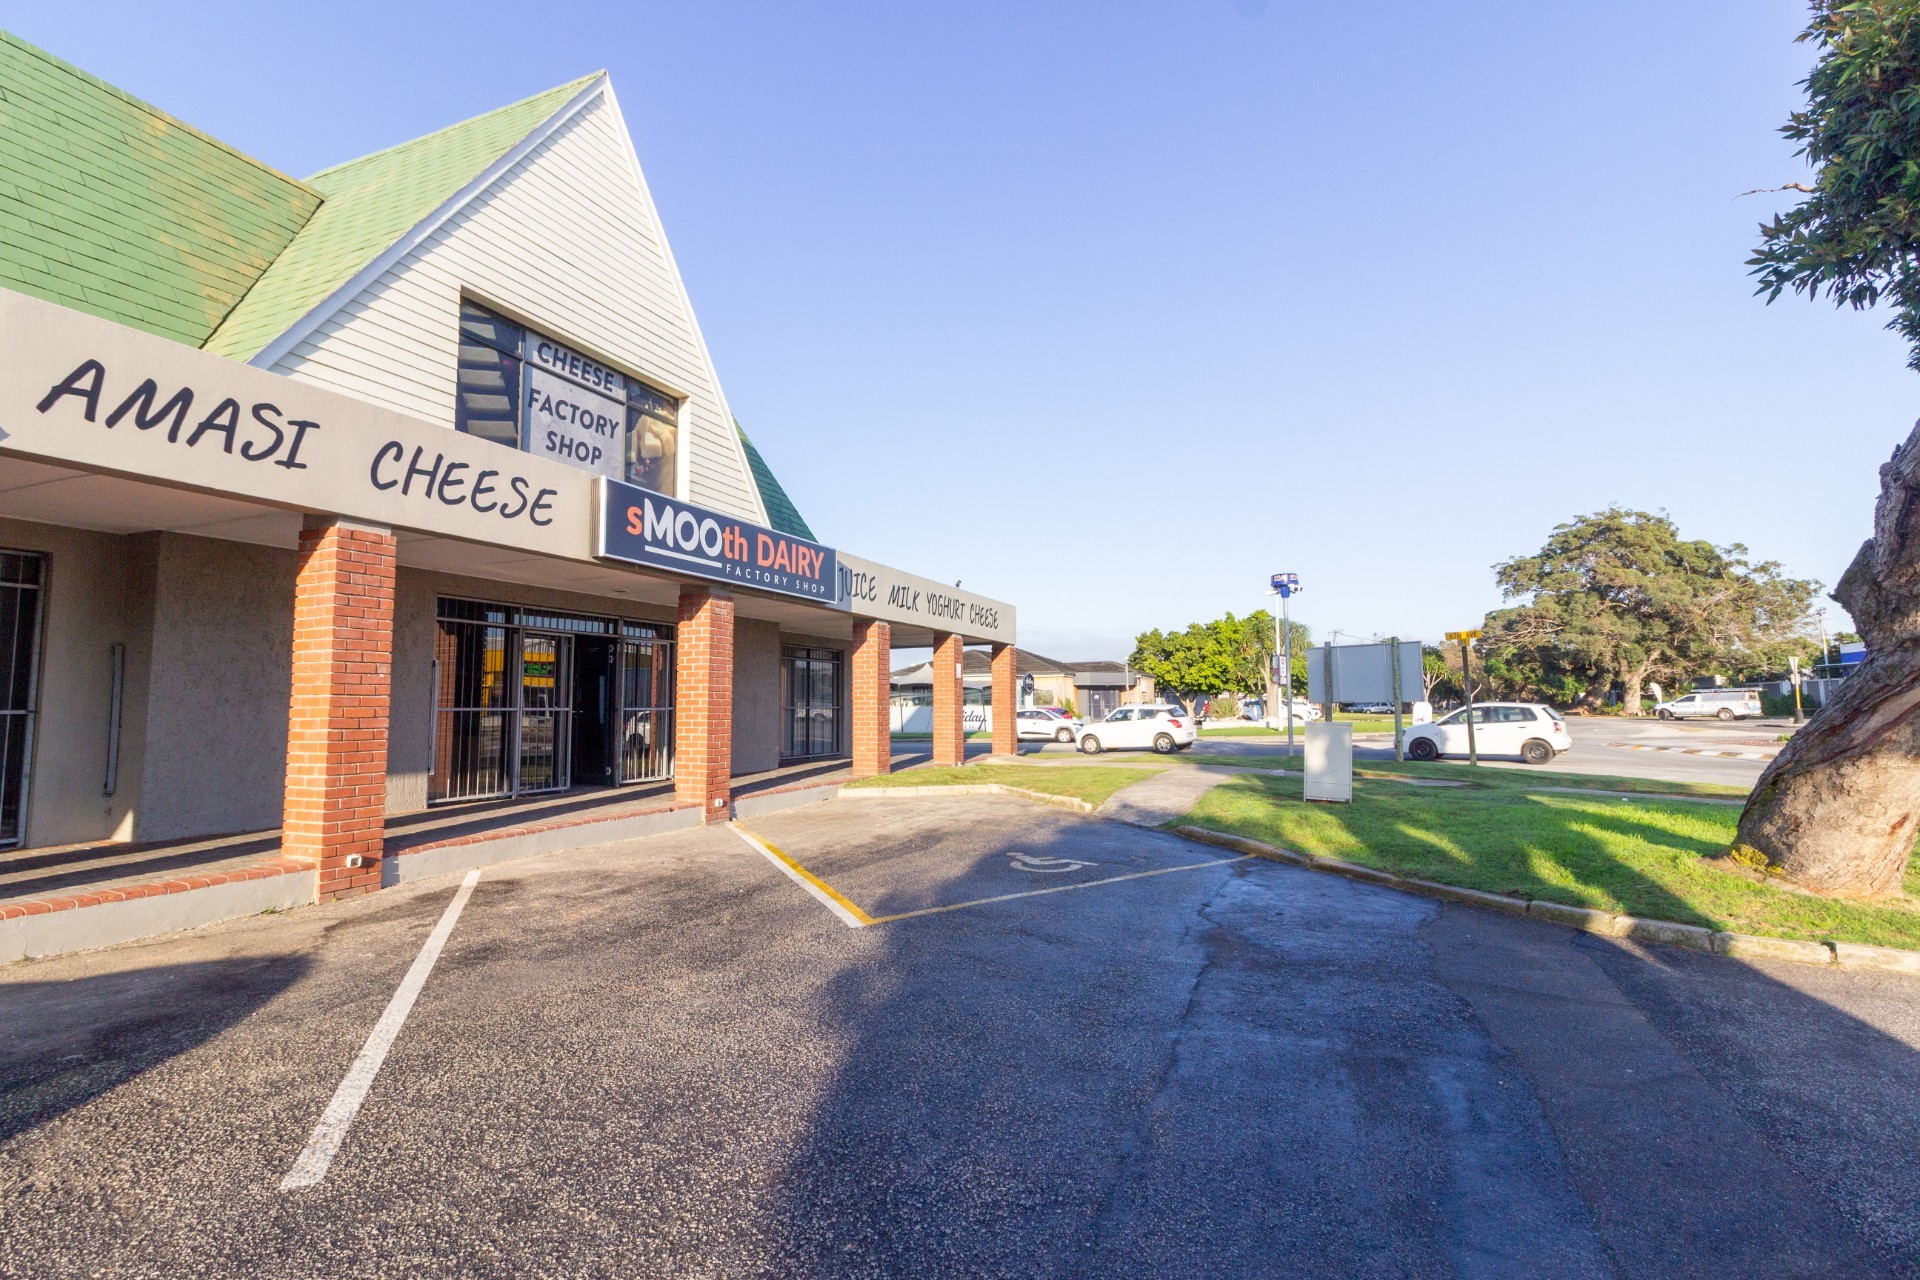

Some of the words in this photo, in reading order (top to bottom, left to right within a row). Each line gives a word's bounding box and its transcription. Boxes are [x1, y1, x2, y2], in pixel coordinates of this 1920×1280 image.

[537, 342, 615, 392] CHEESE
[527, 387, 620, 439] FACTORY
[36, 359, 320, 470] AMASI
[370, 440, 558, 526] CHEESE
[545, 431, 603, 465] SHOP
[626, 498, 748, 562] sMOOth
[757, 533, 825, 580] DAIRY
[726, 563, 788, 587] FACTORY
[796, 579, 826, 595] SHOP
[838, 567, 877, 602] JUICE
[888, 584, 920, 612] MILK
[926, 592, 966, 621] YOGHURT
[969, 603, 999, 629] CHEESE
